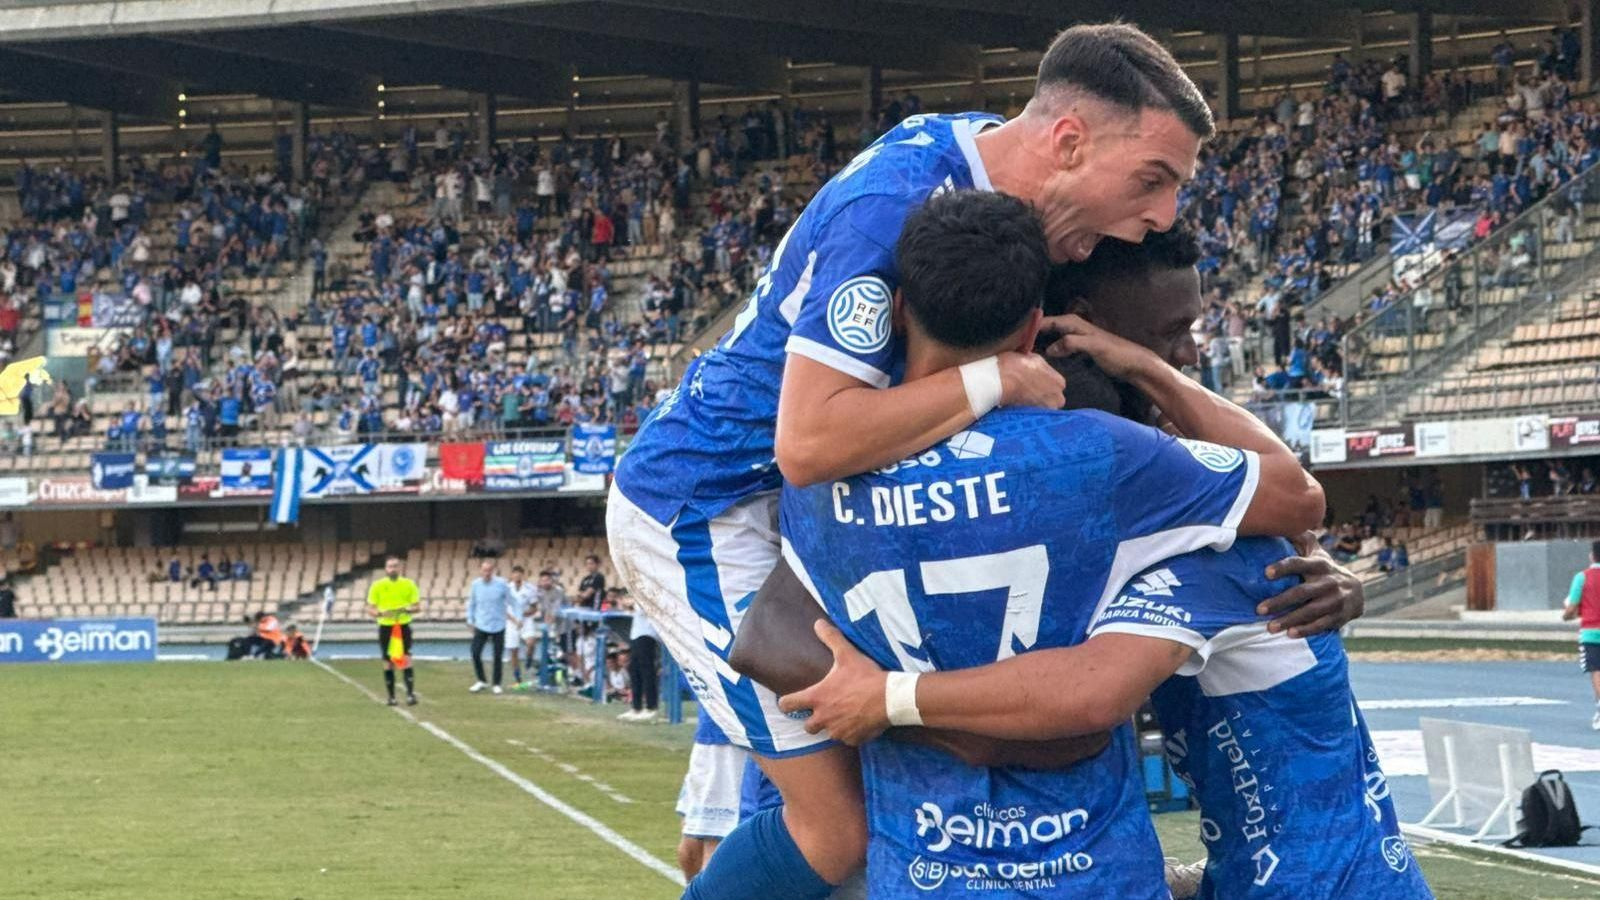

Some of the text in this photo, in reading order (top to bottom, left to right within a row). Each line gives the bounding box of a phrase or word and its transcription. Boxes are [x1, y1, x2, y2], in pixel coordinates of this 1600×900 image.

[832, 471, 1011, 527] C. DIESTE
[843, 544, 1050, 672] 17
[1108, 595, 1192, 624] UZUKI
[1207, 717, 1268, 843] FoxField
